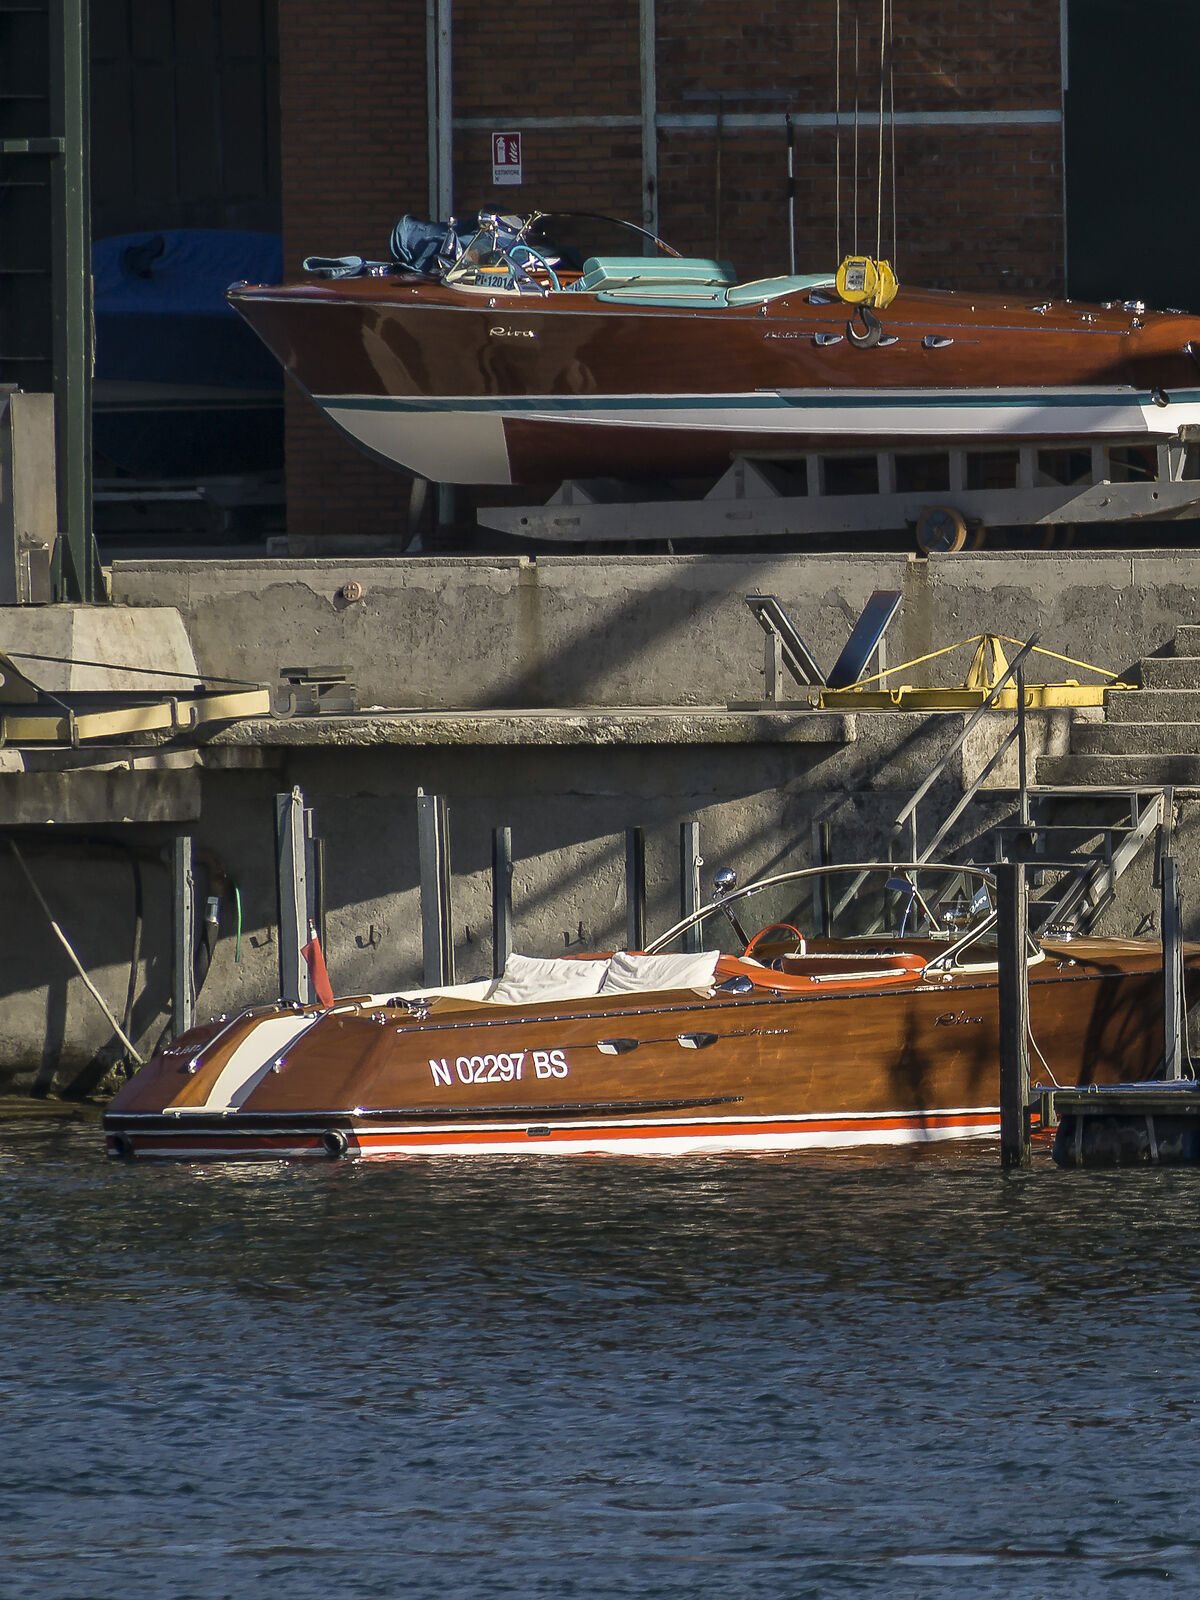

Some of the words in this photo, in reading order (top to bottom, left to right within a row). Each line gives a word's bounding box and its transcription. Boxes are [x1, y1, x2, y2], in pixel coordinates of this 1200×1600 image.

[489, 326, 535, 338] Riva
[429, 1058, 452, 1087] N
[455, 1052, 525, 1084] 02297
[532, 1050, 569, 1079] BS
